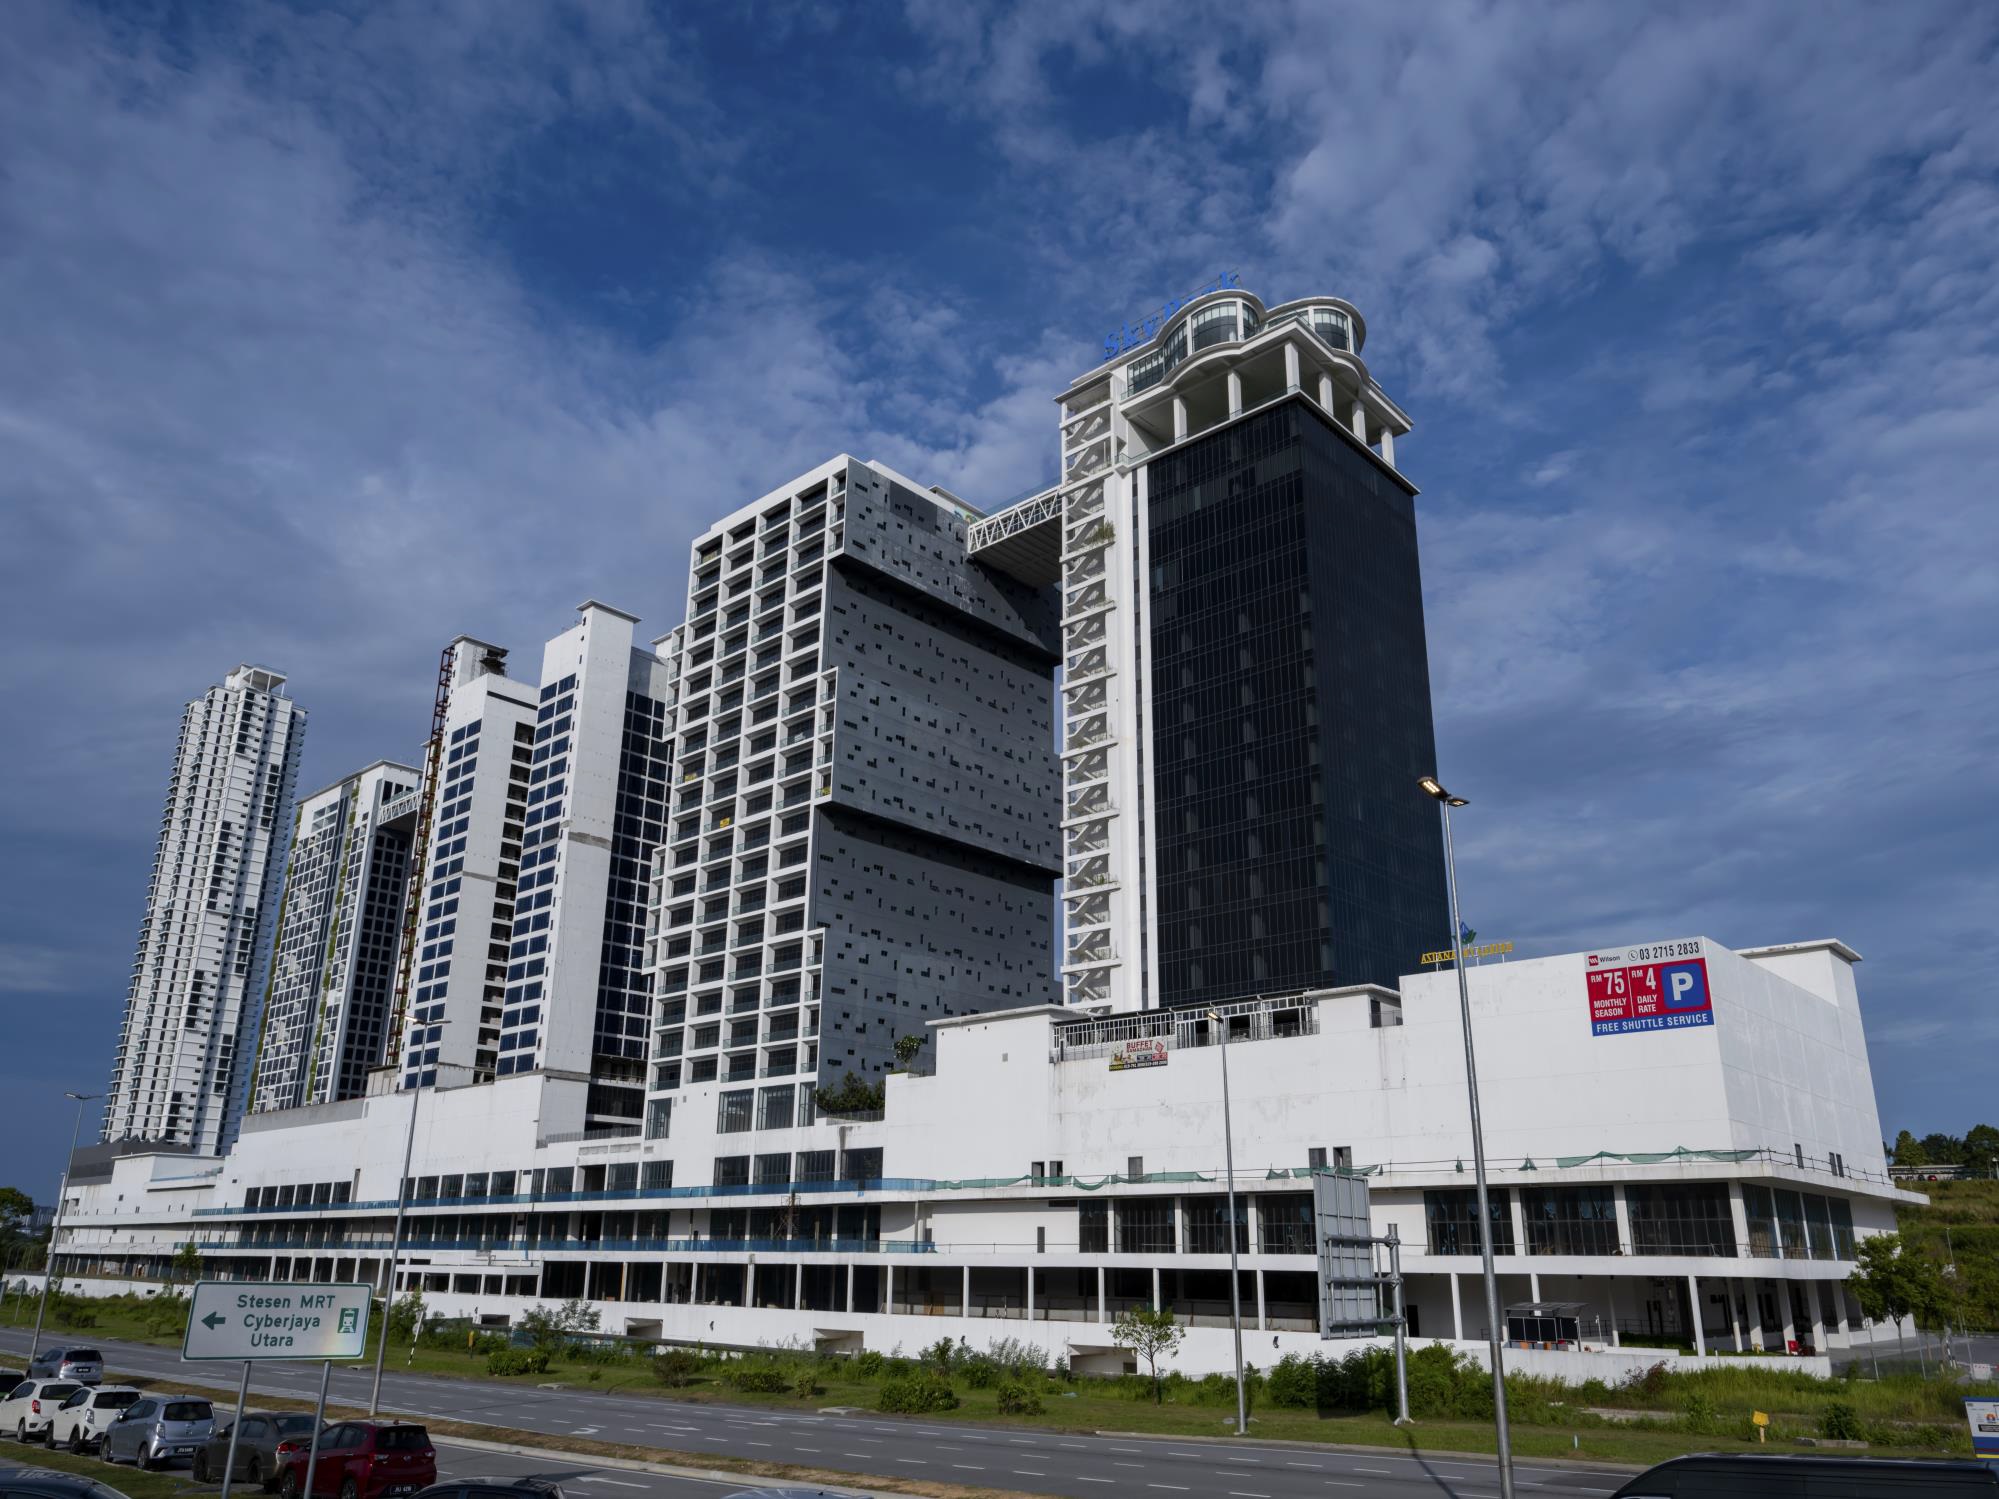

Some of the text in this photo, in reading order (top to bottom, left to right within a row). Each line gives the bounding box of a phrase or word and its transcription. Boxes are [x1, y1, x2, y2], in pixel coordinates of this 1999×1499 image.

[1640, 941, 1699, 960] 03 2715 2833
[1590, 971, 1625, 995] RM 75
[1631, 967, 1657, 990] RM 4
[1670, 972, 1694, 1001] P
[1594, 998, 1627, 1009] MONTHLY
[1637, 994, 1658, 1004] DAILY
[1594, 1007, 1623, 1018] SEASON
[1638, 1004, 1657, 1014] RATE
[1596, 1013, 1708, 1033] FREE SHUTTLE SERVICE
[1126, 1040, 1153, 1049] BUFFET
[236, 1294, 336, 1309] Stesen MRT
[243, 1314, 321, 1332] Cyberjaya
[250, 1333, 294, 1347] Utara
